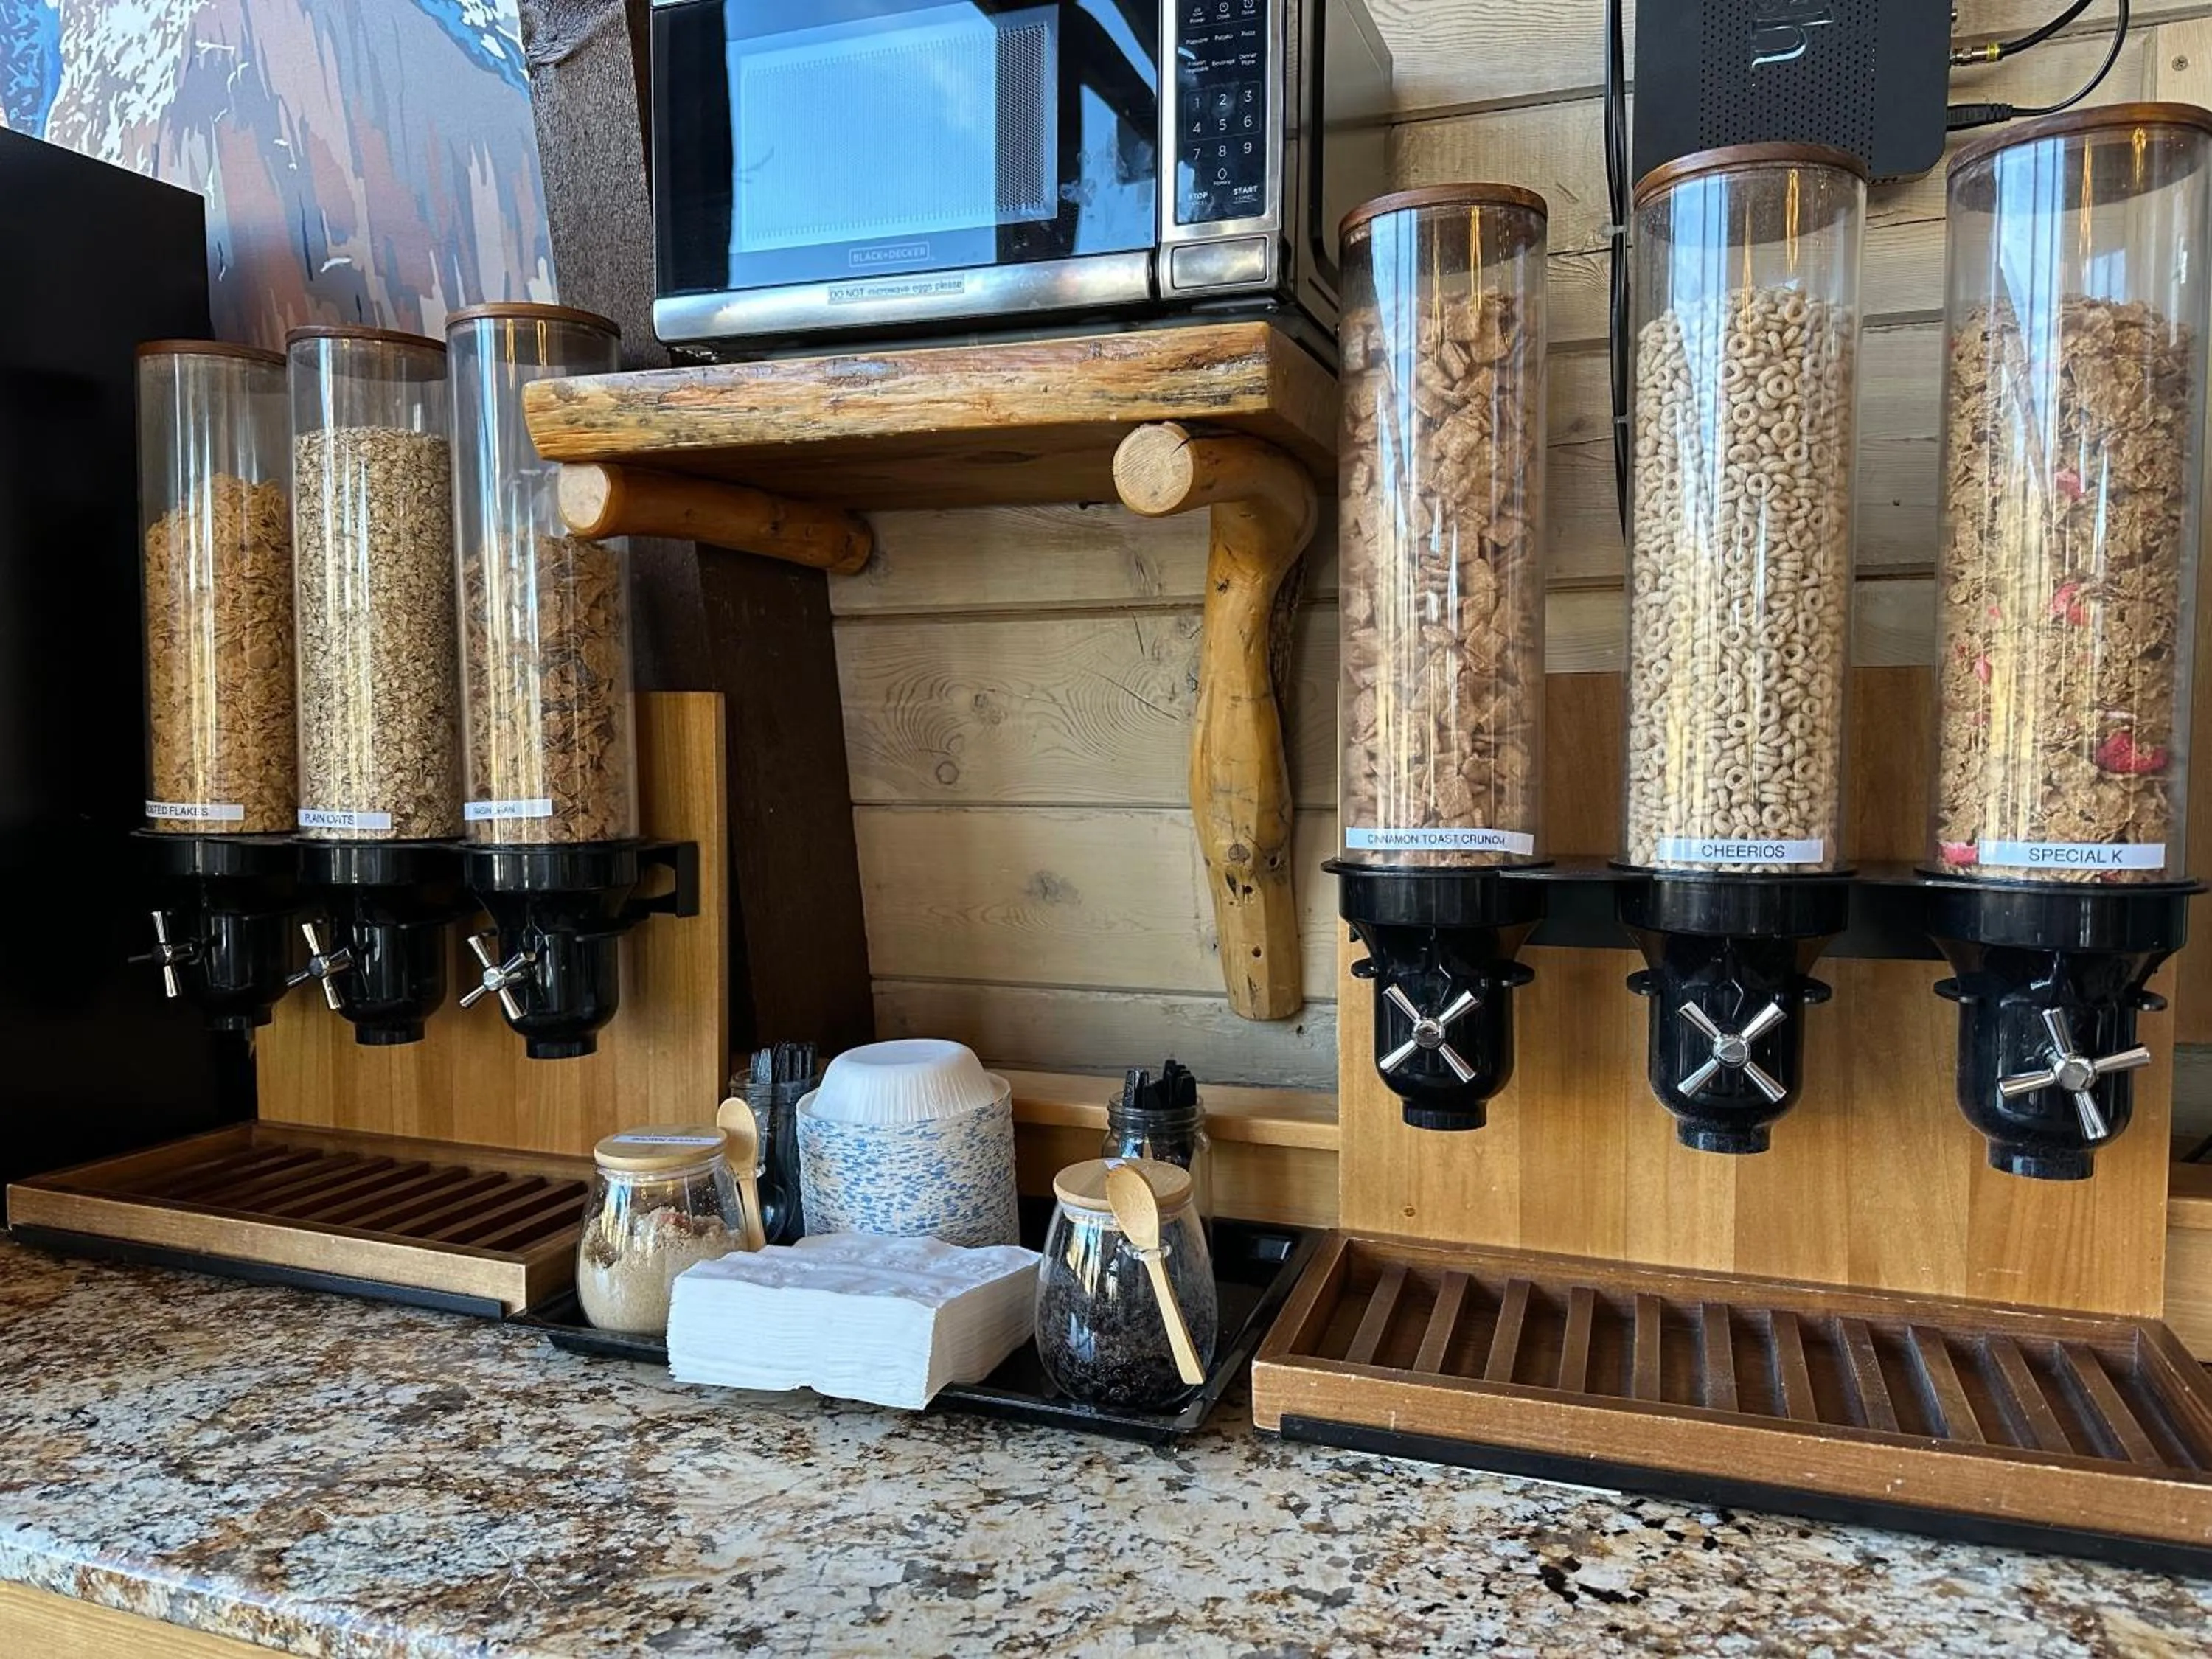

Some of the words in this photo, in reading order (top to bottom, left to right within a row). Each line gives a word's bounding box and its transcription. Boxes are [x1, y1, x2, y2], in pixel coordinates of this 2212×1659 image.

[1194, 97, 1200, 108] 1
[1219, 94, 1227, 105] 2
[1244, 90, 1252, 102] 3
[1192, 122, 1201, 133] 4
[1219, 119, 1227, 131] 5
[1244, 115, 1252, 128] 6
[1193, 148, 1201, 160] 7
[1218, 145, 1227, 157] 8
[1243, 142, 1252, 154] 9
[1217, 167, 1228, 181] 0
[1188, 192, 1208, 200] STOP
[1233, 185, 1259, 195] START
[830, 290, 844, 300] DO
[846, 288, 864, 298] NOT
[868, 285, 910, 296] microwave
[912, 283, 933, 295] eggs
[935, 279, 963, 292] please
[327, 813, 355, 825] OATS
[1368, 833, 1419, 845] CINNAMON
[1422, 834, 1458, 845] TOAST
[1461, 834, 1506, 846] CRUNCH
[1701, 844, 1786, 859] CHEERIOS
[2028, 847, 2107, 864] SPECIAL
[2111, 849, 2124, 864] K
